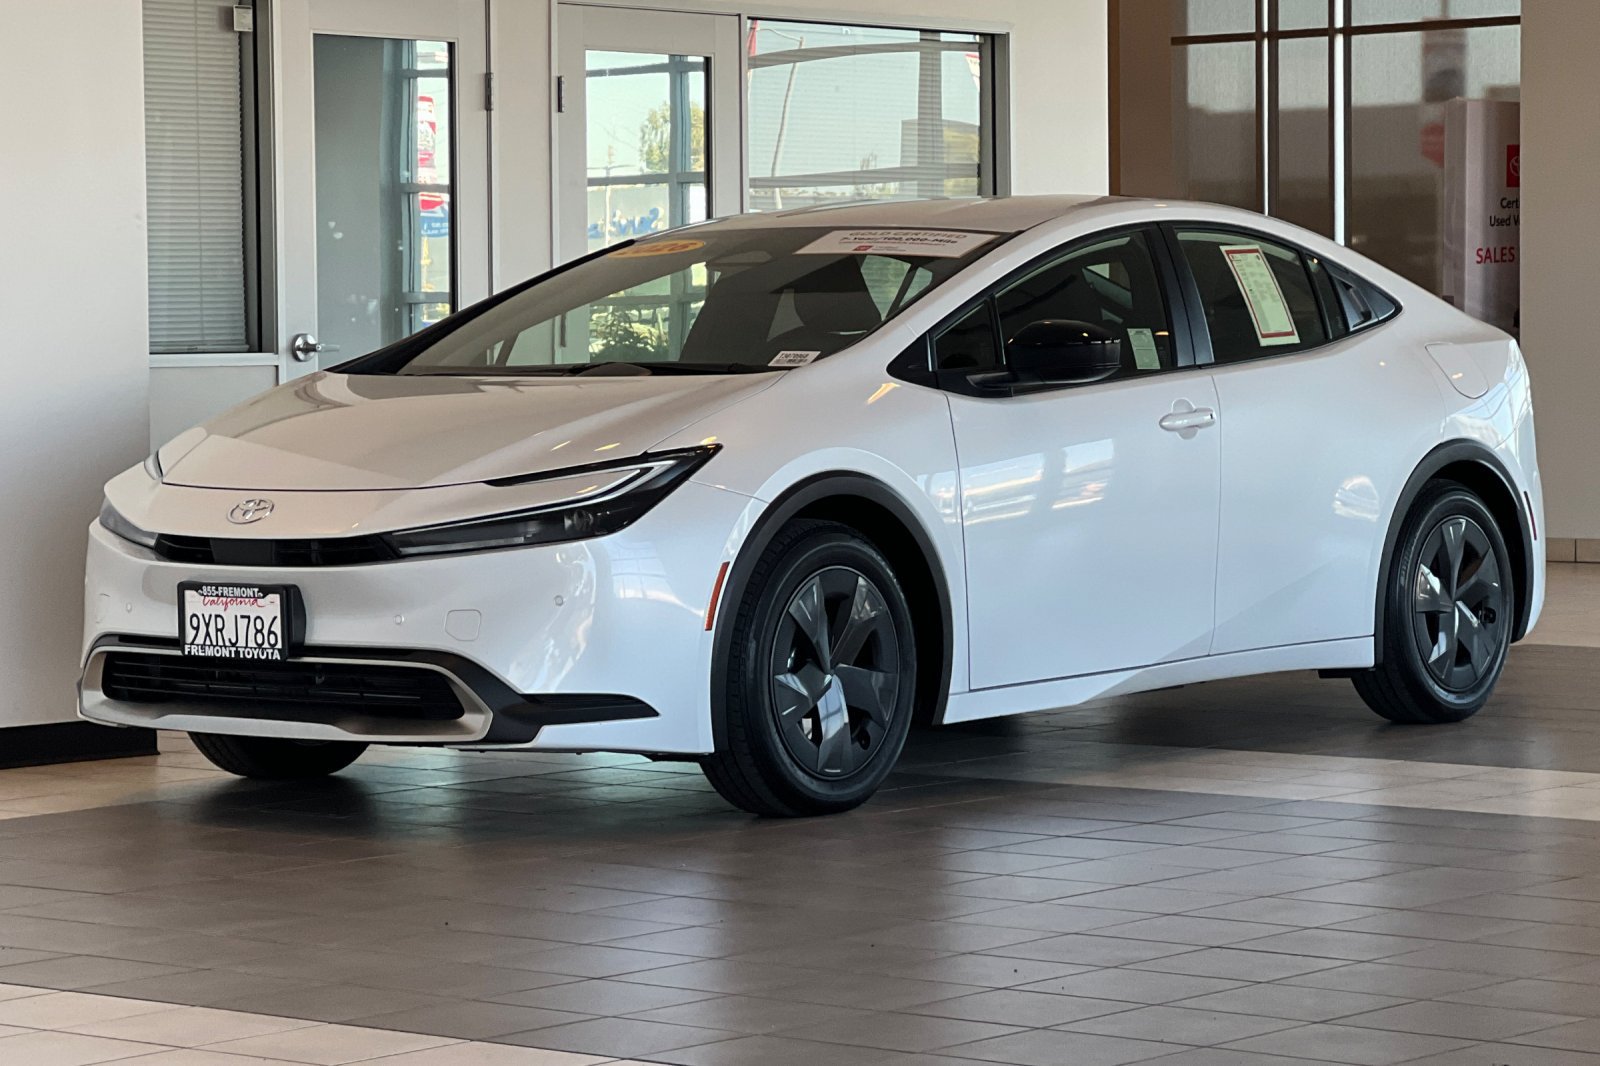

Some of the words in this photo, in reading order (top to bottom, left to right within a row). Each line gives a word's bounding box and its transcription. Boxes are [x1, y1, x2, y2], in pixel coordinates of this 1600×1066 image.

[1489, 214, 1511, 226] Used
[1476, 247, 1516, 264] SALES
[203, 597, 265, 611] California
[189, 613, 279, 648] 9XRJ786
[184, 645, 237, 658] FREMONT
[239, 648, 280, 660] TOYOTA
